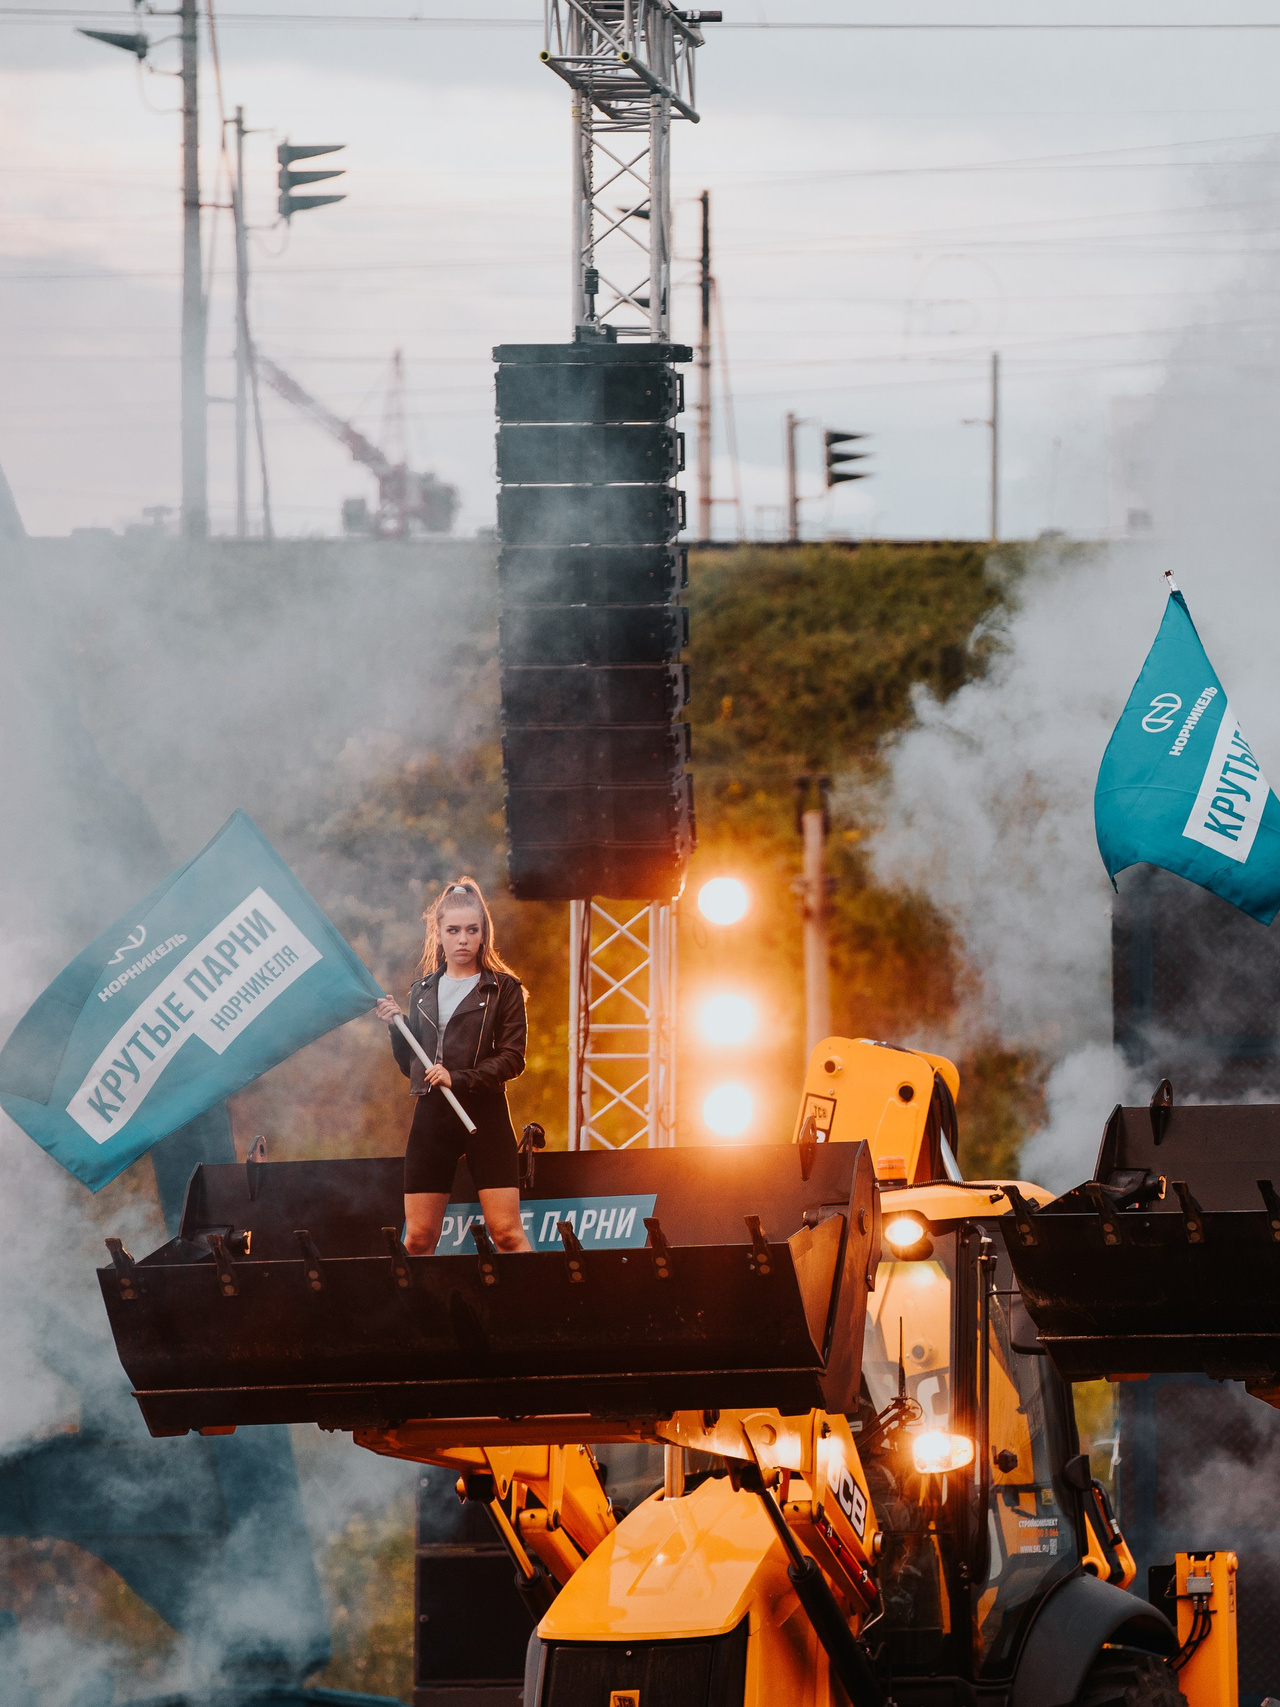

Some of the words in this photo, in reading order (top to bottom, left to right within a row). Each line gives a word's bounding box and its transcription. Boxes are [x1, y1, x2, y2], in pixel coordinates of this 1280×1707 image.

[1169, 685, 1218, 757] НОРНИКЕЛЬ
[97, 932, 188, 1003] НОРНИКЕЛЬ
[209, 944, 300, 1032] НОРНИКЕЛЯ
[86, 991, 195, 1124] КРУТЫЕ
[182, 907, 277, 1003] ПАРНИ
